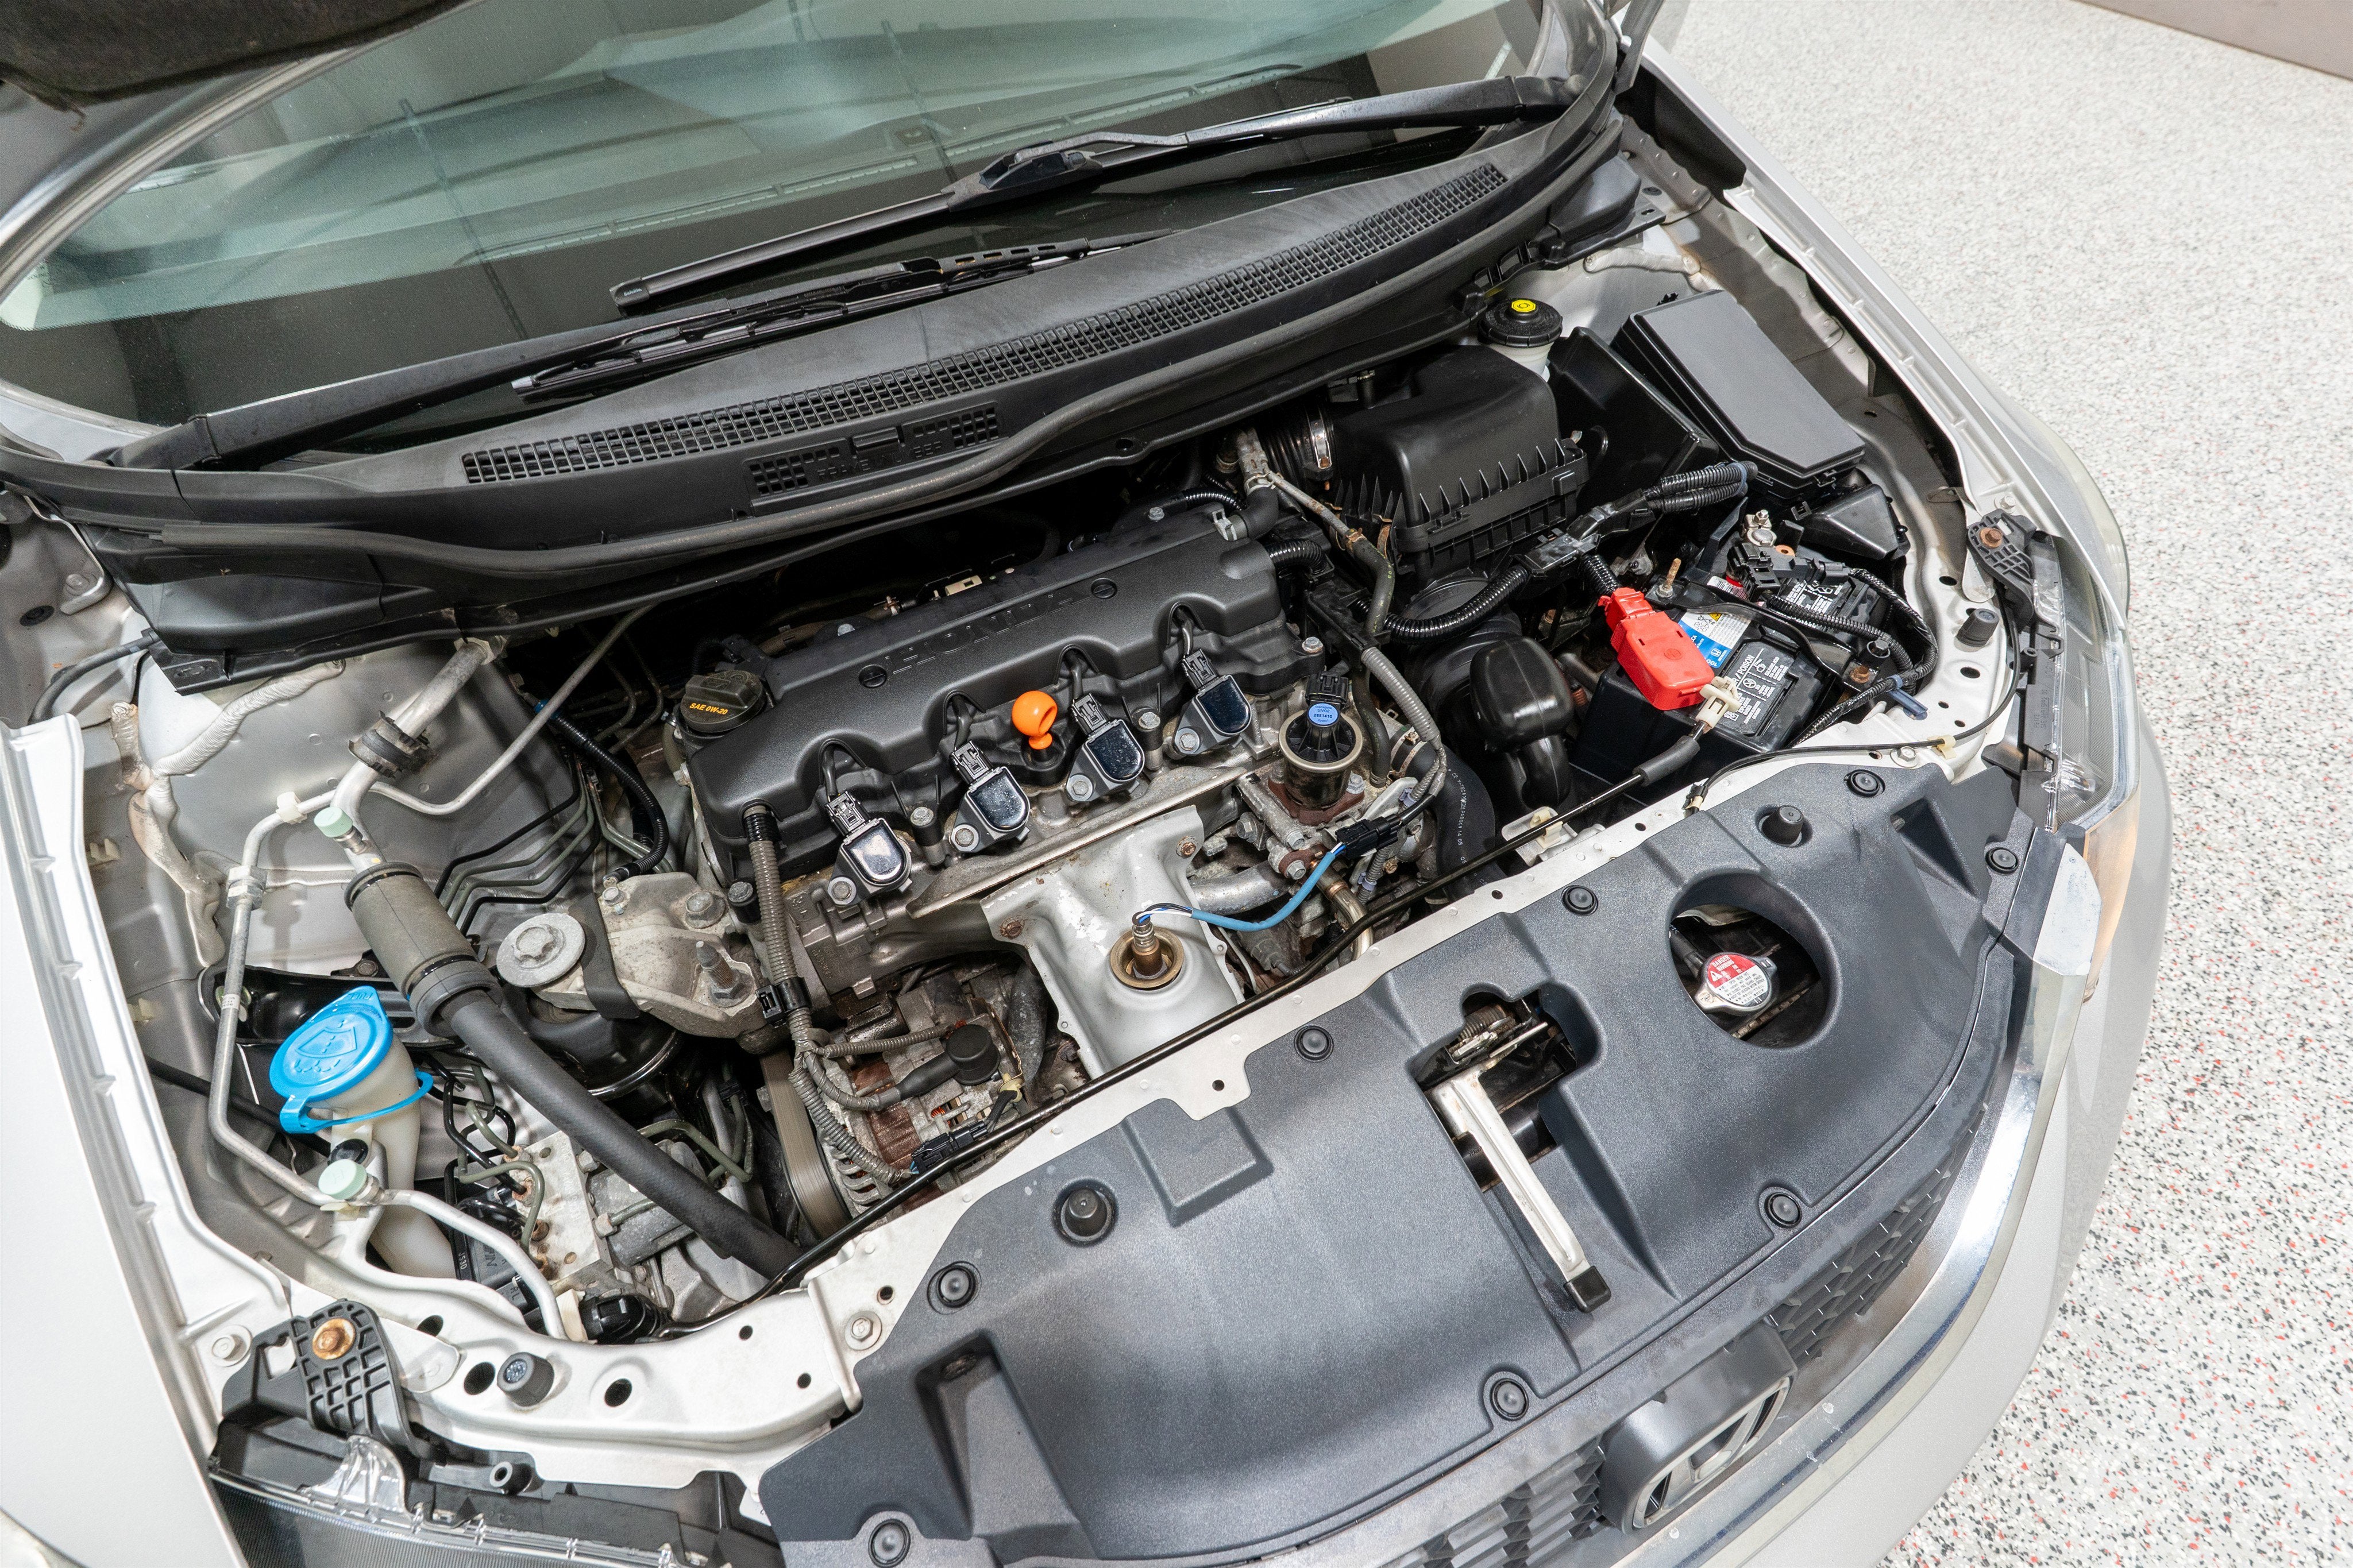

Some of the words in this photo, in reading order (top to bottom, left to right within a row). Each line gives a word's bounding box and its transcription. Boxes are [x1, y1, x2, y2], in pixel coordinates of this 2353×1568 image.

[817, 459, 870, 477] FRAME
[881, 442, 942, 465] NUMBER
[885, 590, 1092, 675] HONDA
[1737, 655, 1755, 675] POISON
[689, 702, 707, 710] SAE
[705, 706, 728, 715] 0W-20
[1711, 955, 1730, 967] DANGER
